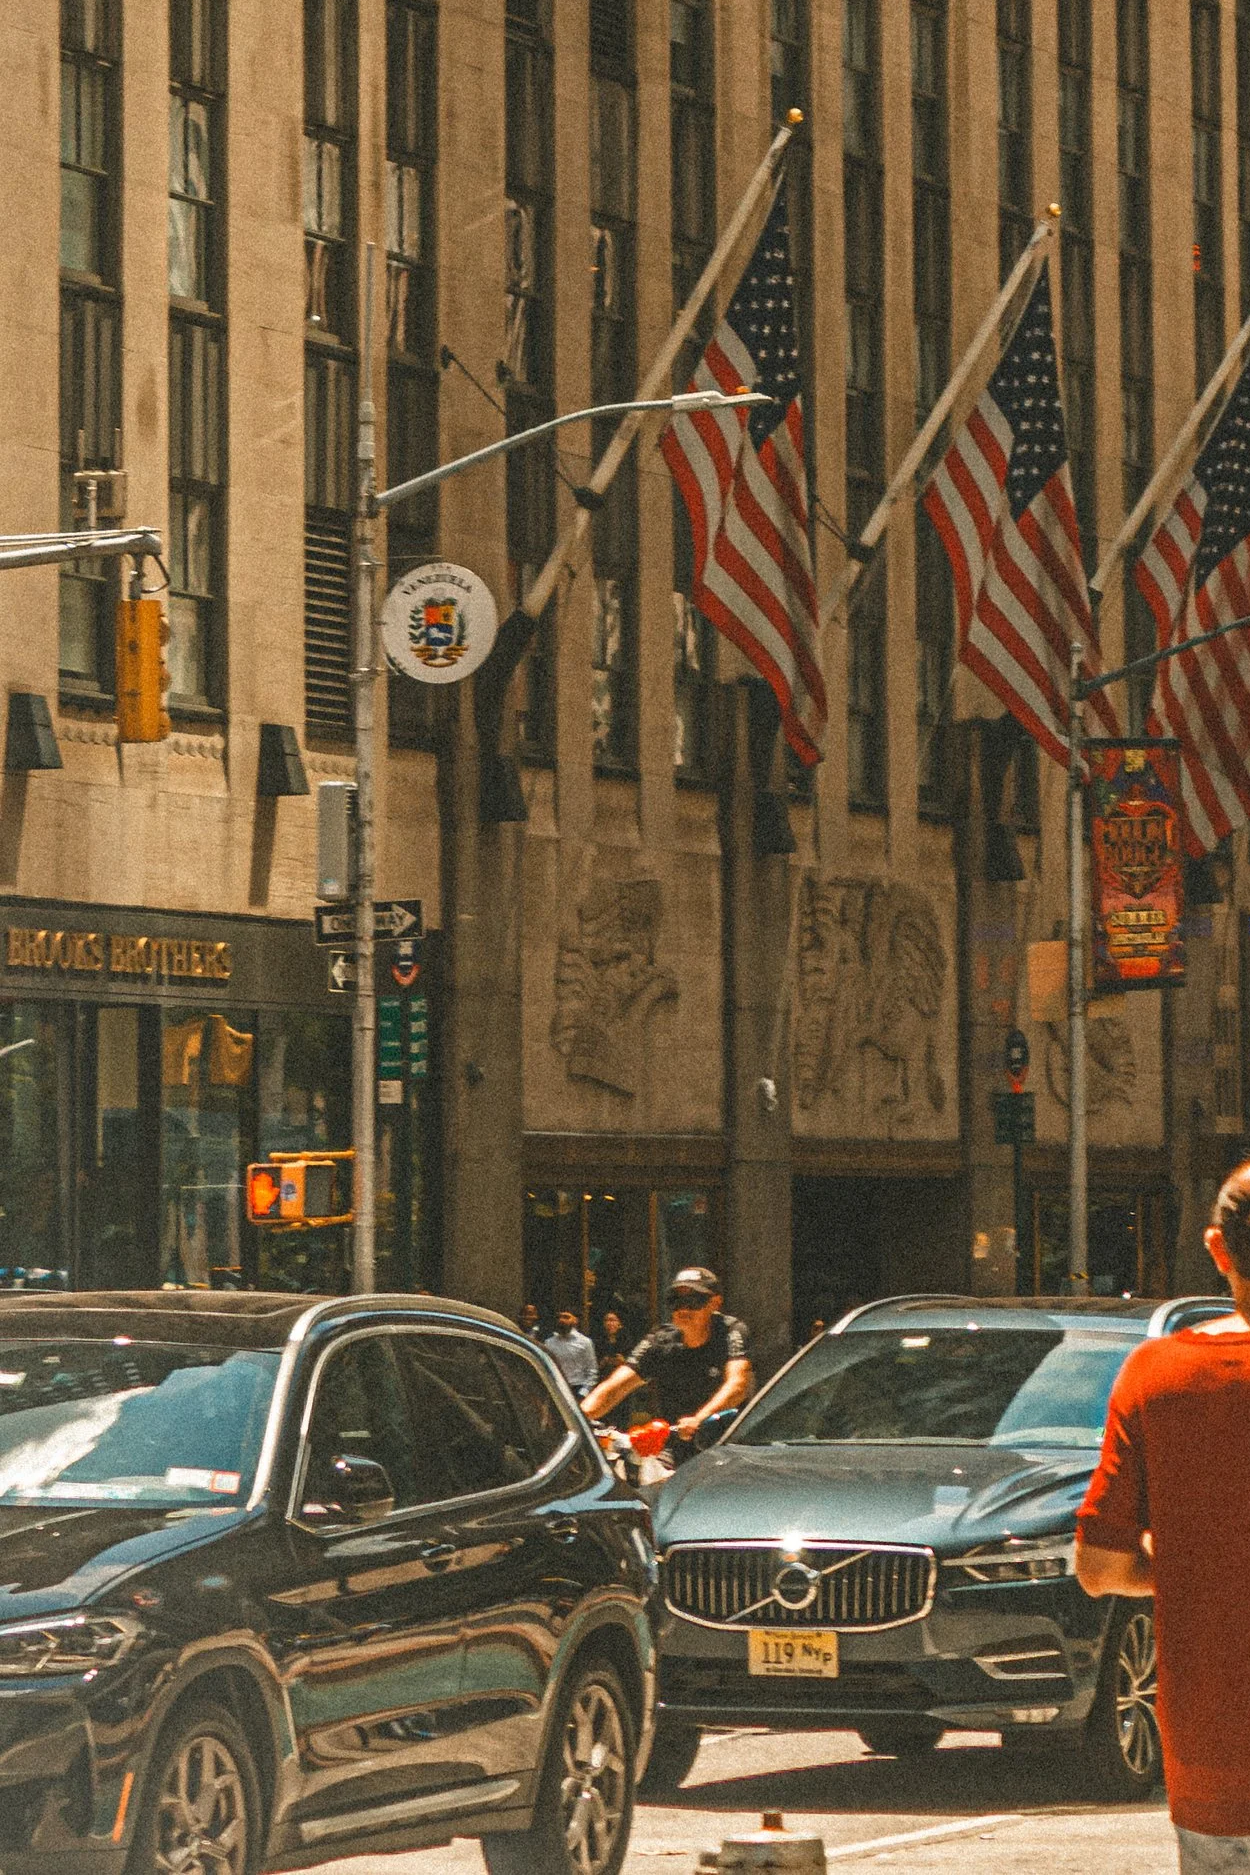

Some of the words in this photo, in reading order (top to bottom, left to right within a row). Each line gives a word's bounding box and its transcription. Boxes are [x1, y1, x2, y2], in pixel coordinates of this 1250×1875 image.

[7, 926, 103, 970] BROOKS
[109, 934, 233, 980] BROTHERS
[762, 1642, 796, 1664] 119
